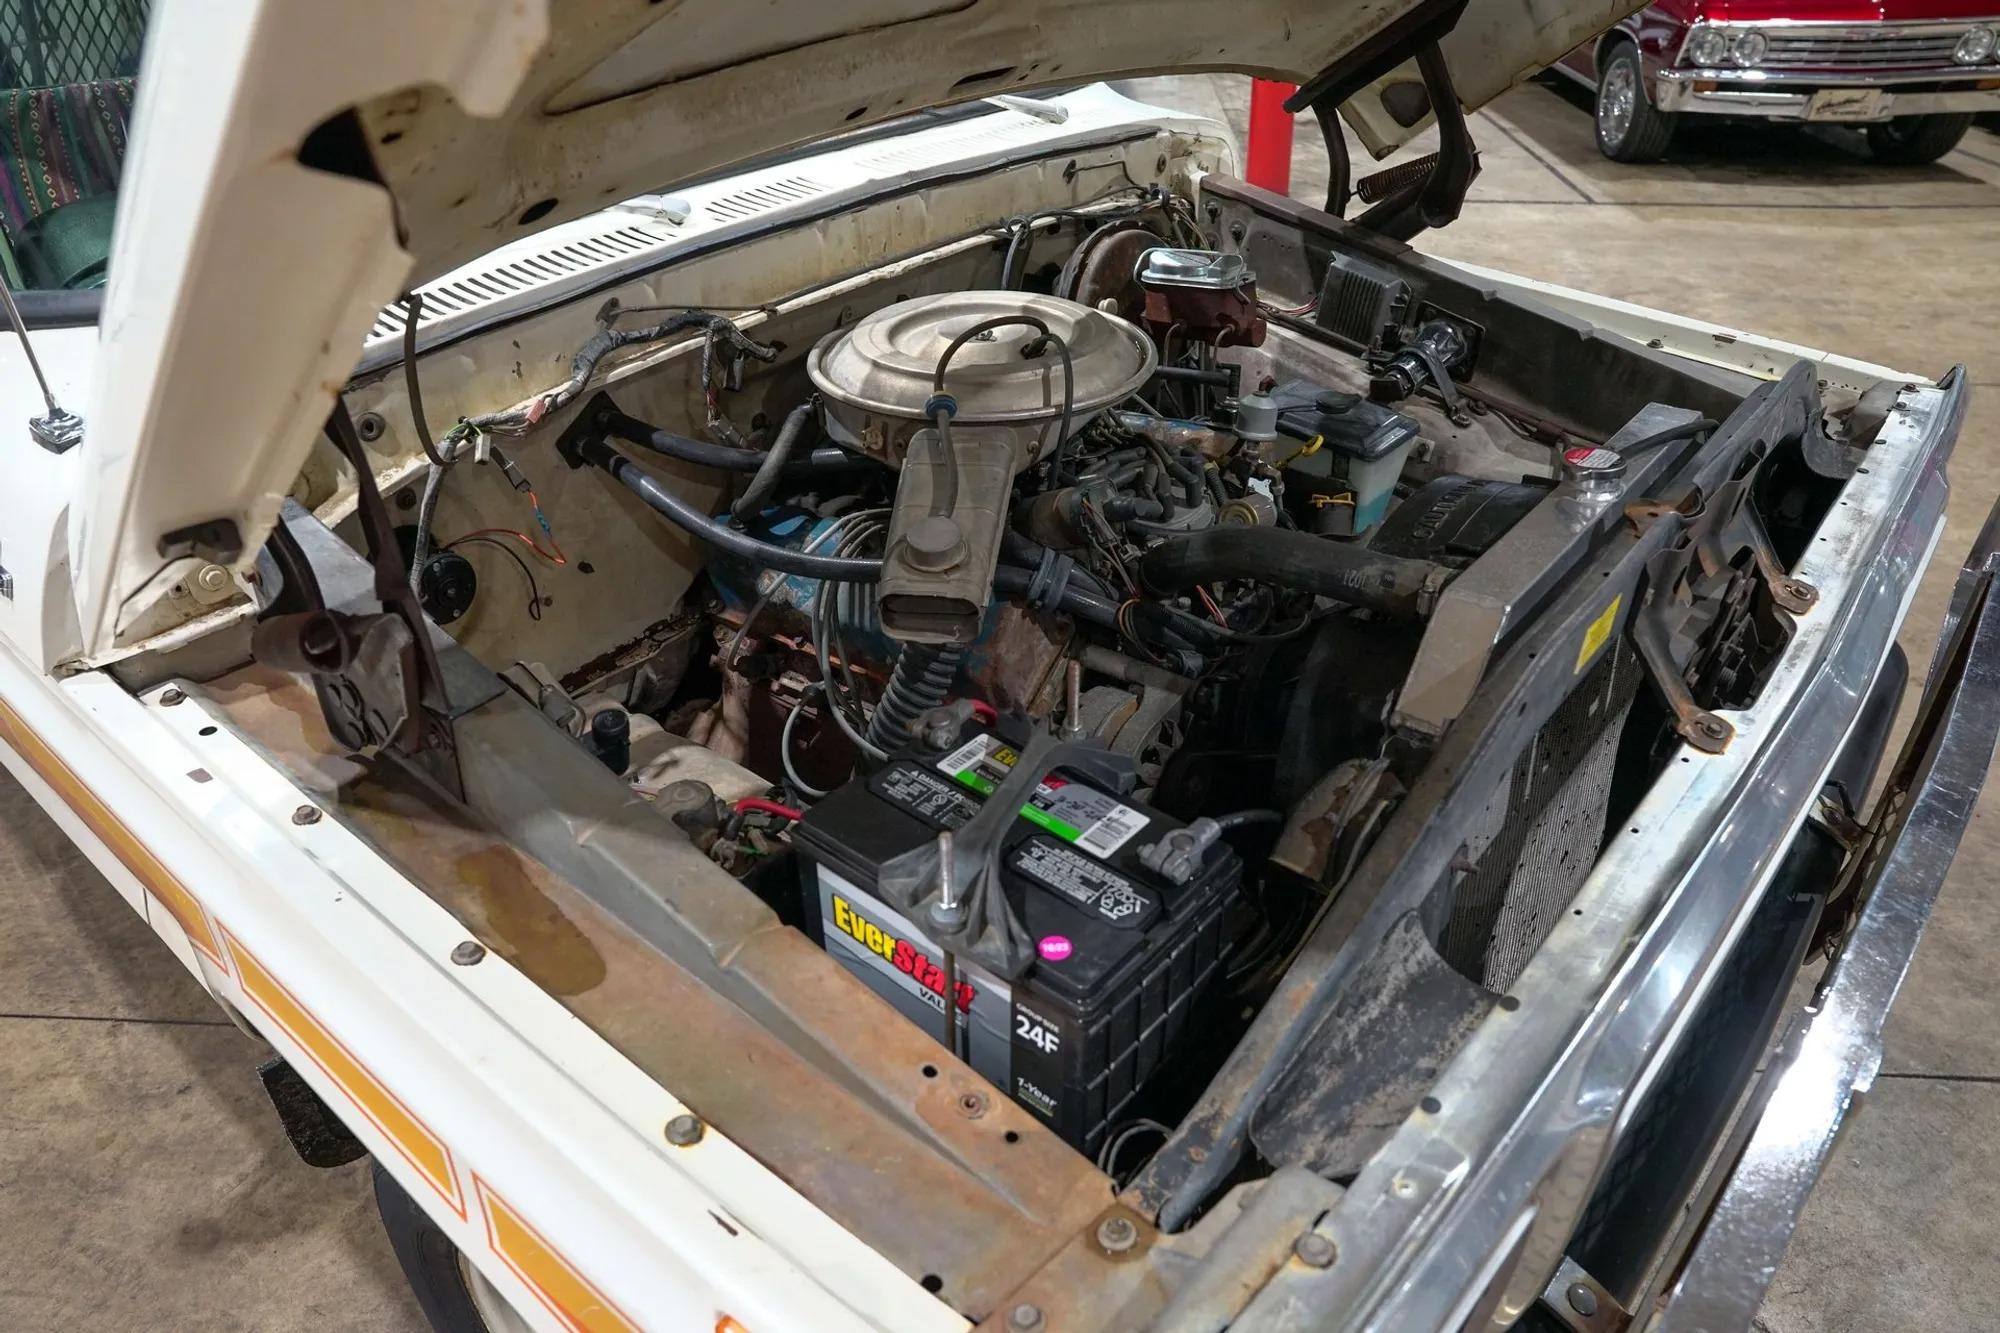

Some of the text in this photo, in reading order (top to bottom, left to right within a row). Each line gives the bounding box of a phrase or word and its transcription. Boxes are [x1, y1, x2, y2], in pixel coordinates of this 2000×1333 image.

[833, 894, 976, 1015] EverStat
[1015, 1013, 1060, 1054] 24F
[1016, 1076, 1058, 1107] 1-Year
